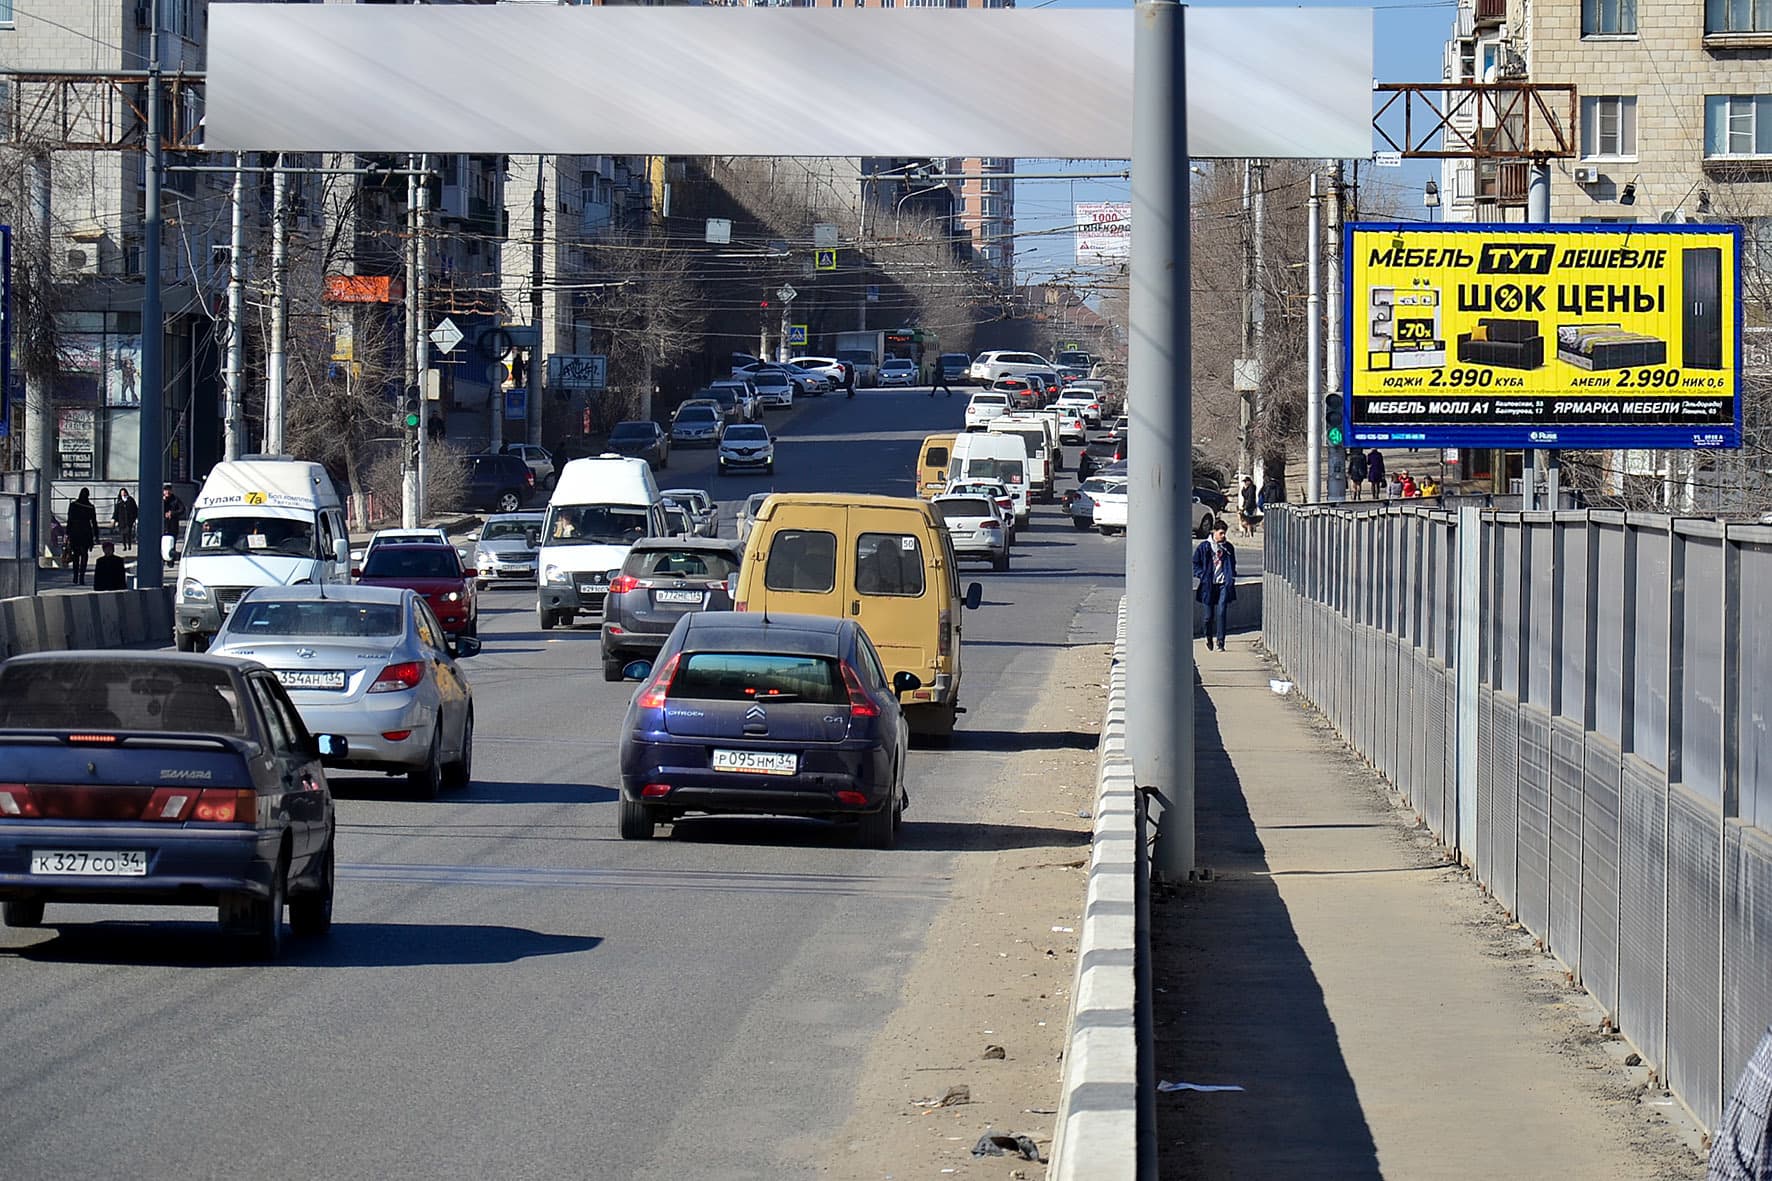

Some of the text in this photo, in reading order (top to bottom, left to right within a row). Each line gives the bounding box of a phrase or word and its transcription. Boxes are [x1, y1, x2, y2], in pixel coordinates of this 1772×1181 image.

[1092, 213, 1118, 222] 1000
[1368, 248, 1667, 269] МЕБЕЛЬ ТУТ ДЕШЕВЛЕ
[1557, 284, 1665, 316] ЦЕНЫ
[1383, 369, 1524, 388] ЮДЖИ 2.990 КУБА
[1570, 369, 1725, 389] АМЕЛИ 2.990 НИК 0,6
[1367, 401, 1490, 415] МЕБЕЛЬ МОЛЛ А1
[1552, 401, 1681, 415] ЯРМАРКА МЕБЕЛИ
[203, 495, 242, 506] Тулака
[247, 491, 263, 505] 7а
[903, 540, 914, 548] 50
[279, 671, 320, 685] 354АН
[160, 769, 212, 779] SAMARA
